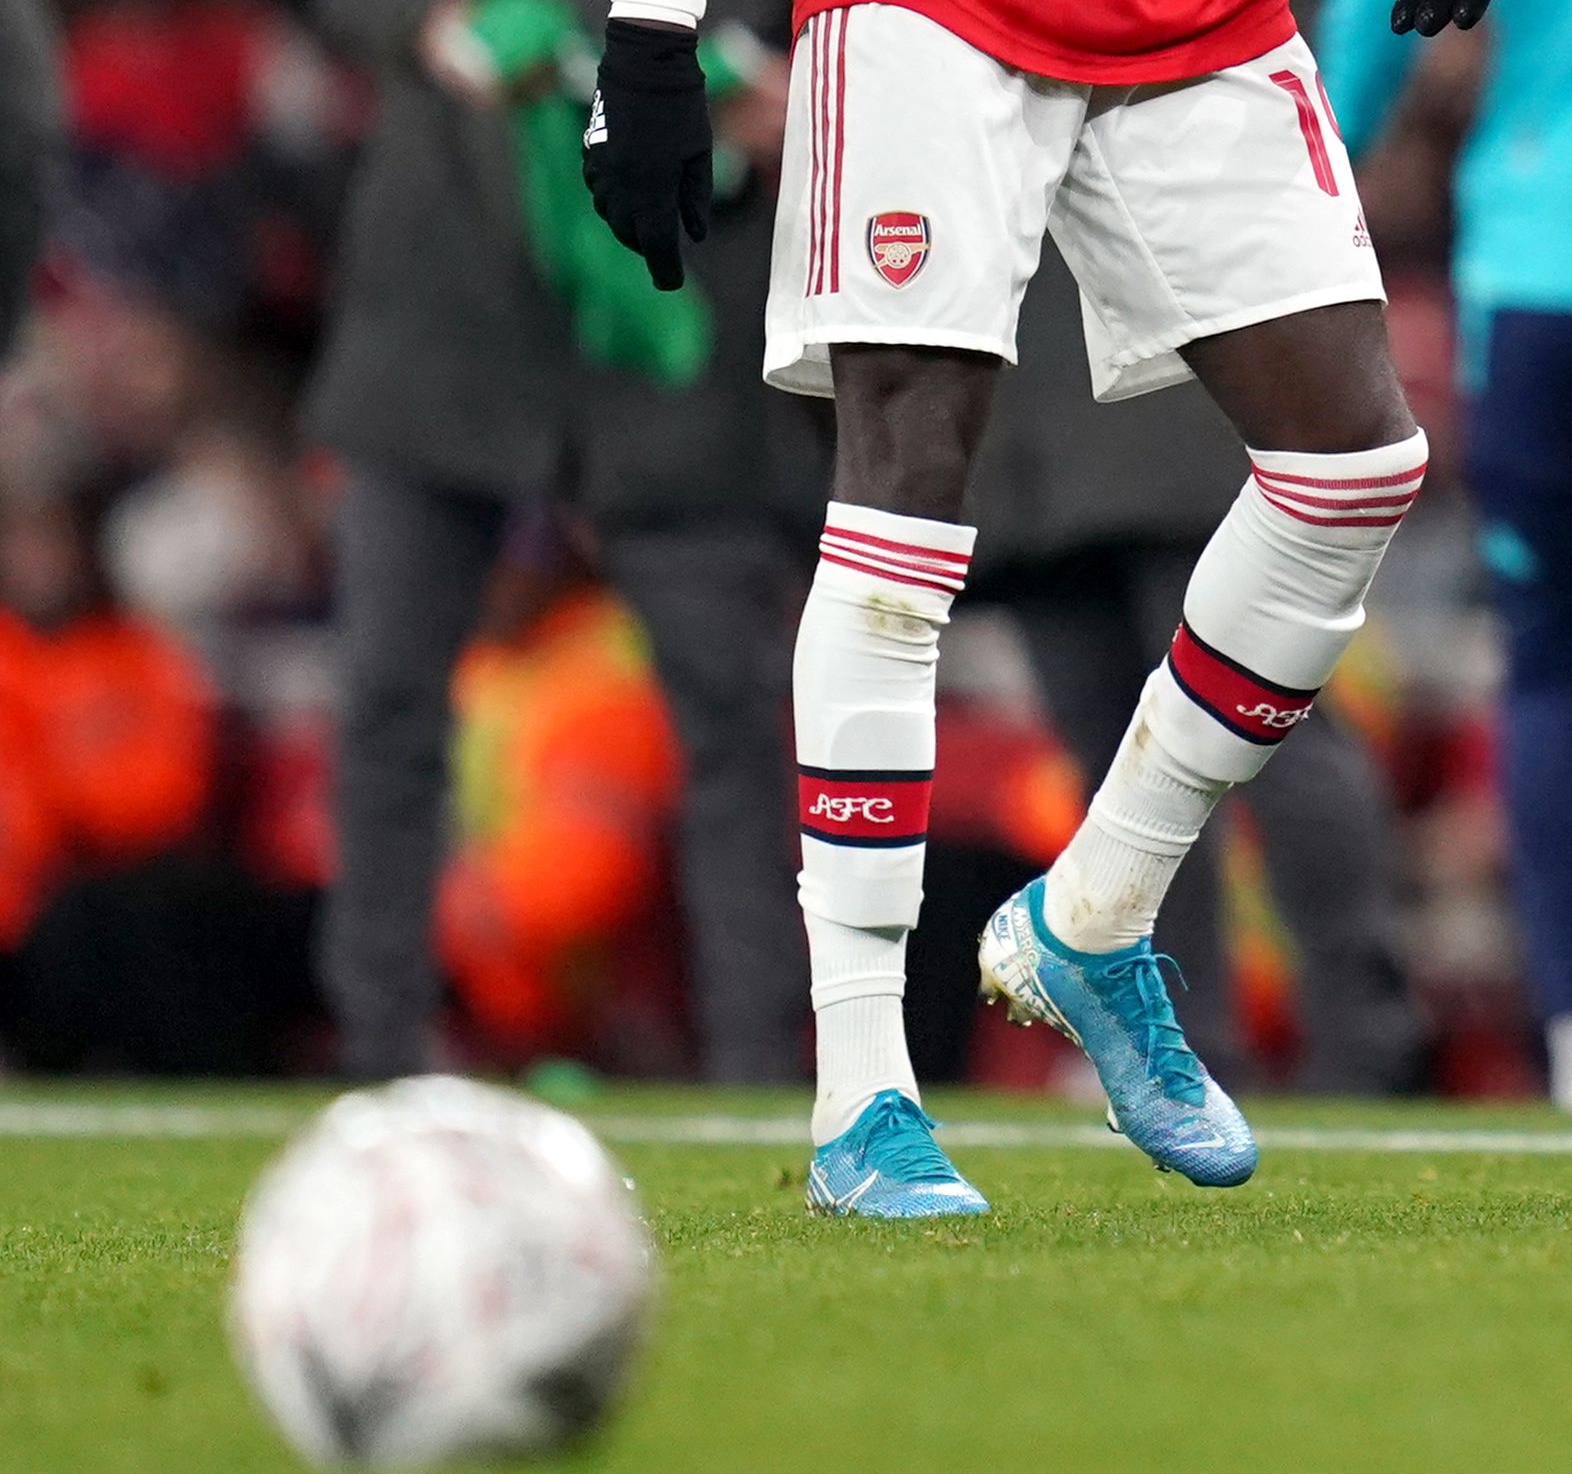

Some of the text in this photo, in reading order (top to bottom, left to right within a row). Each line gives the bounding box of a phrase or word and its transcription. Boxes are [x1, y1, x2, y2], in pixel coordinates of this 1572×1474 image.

[1268, 69, 1342, 197] 1
[874, 224, 921, 236] Arsenal
[808, 792, 895, 823] AFC
